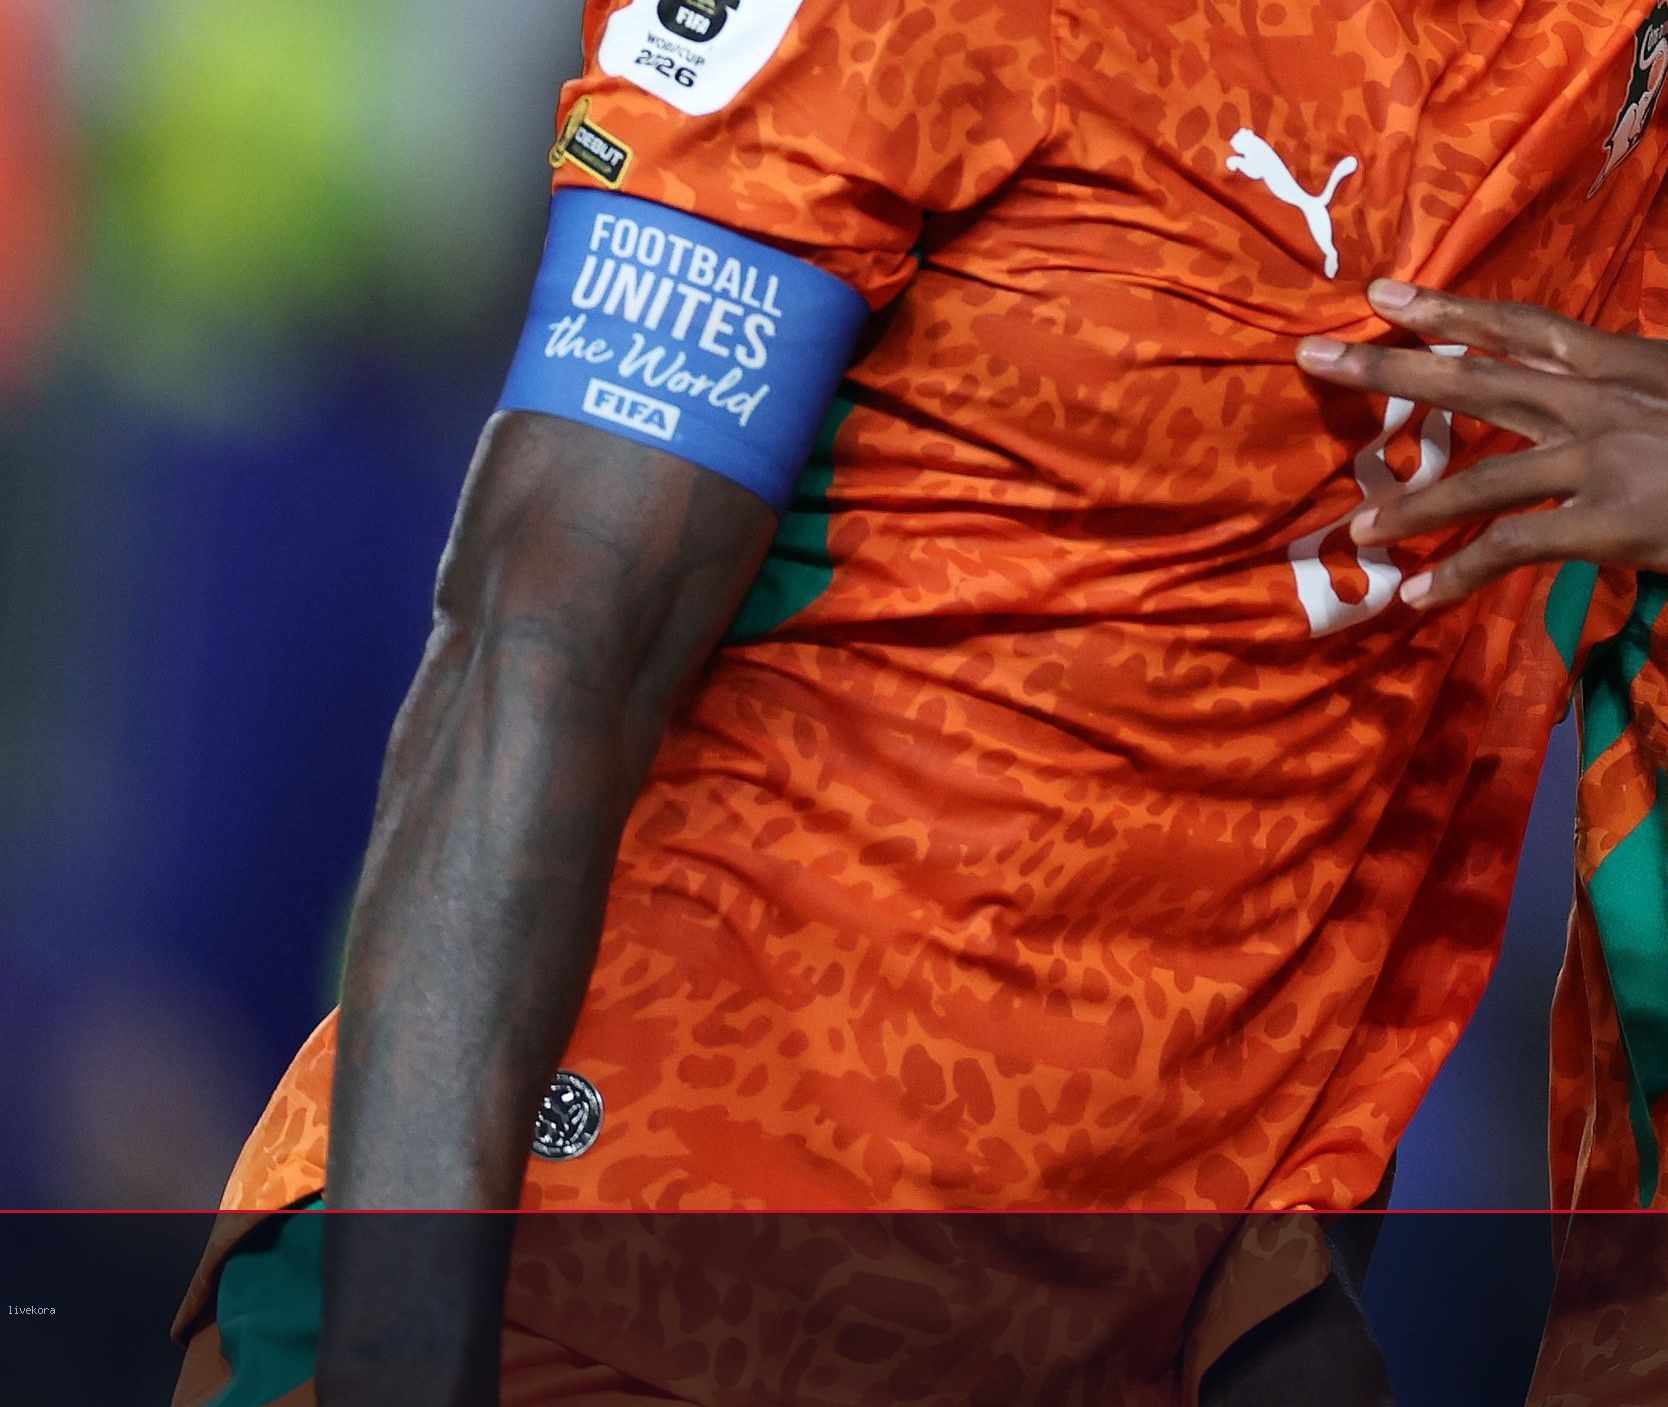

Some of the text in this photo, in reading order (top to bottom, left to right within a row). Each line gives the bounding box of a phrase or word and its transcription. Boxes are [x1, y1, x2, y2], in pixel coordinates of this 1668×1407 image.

[634, 48, 698, 89] 226
[574, 125, 625, 167] DEBUT
[589, 212, 783, 319] FOOTBALL
[571, 254, 777, 370] UNITES
[544, 312, 771, 427] the World
[591, 385, 669, 432] FIFA
